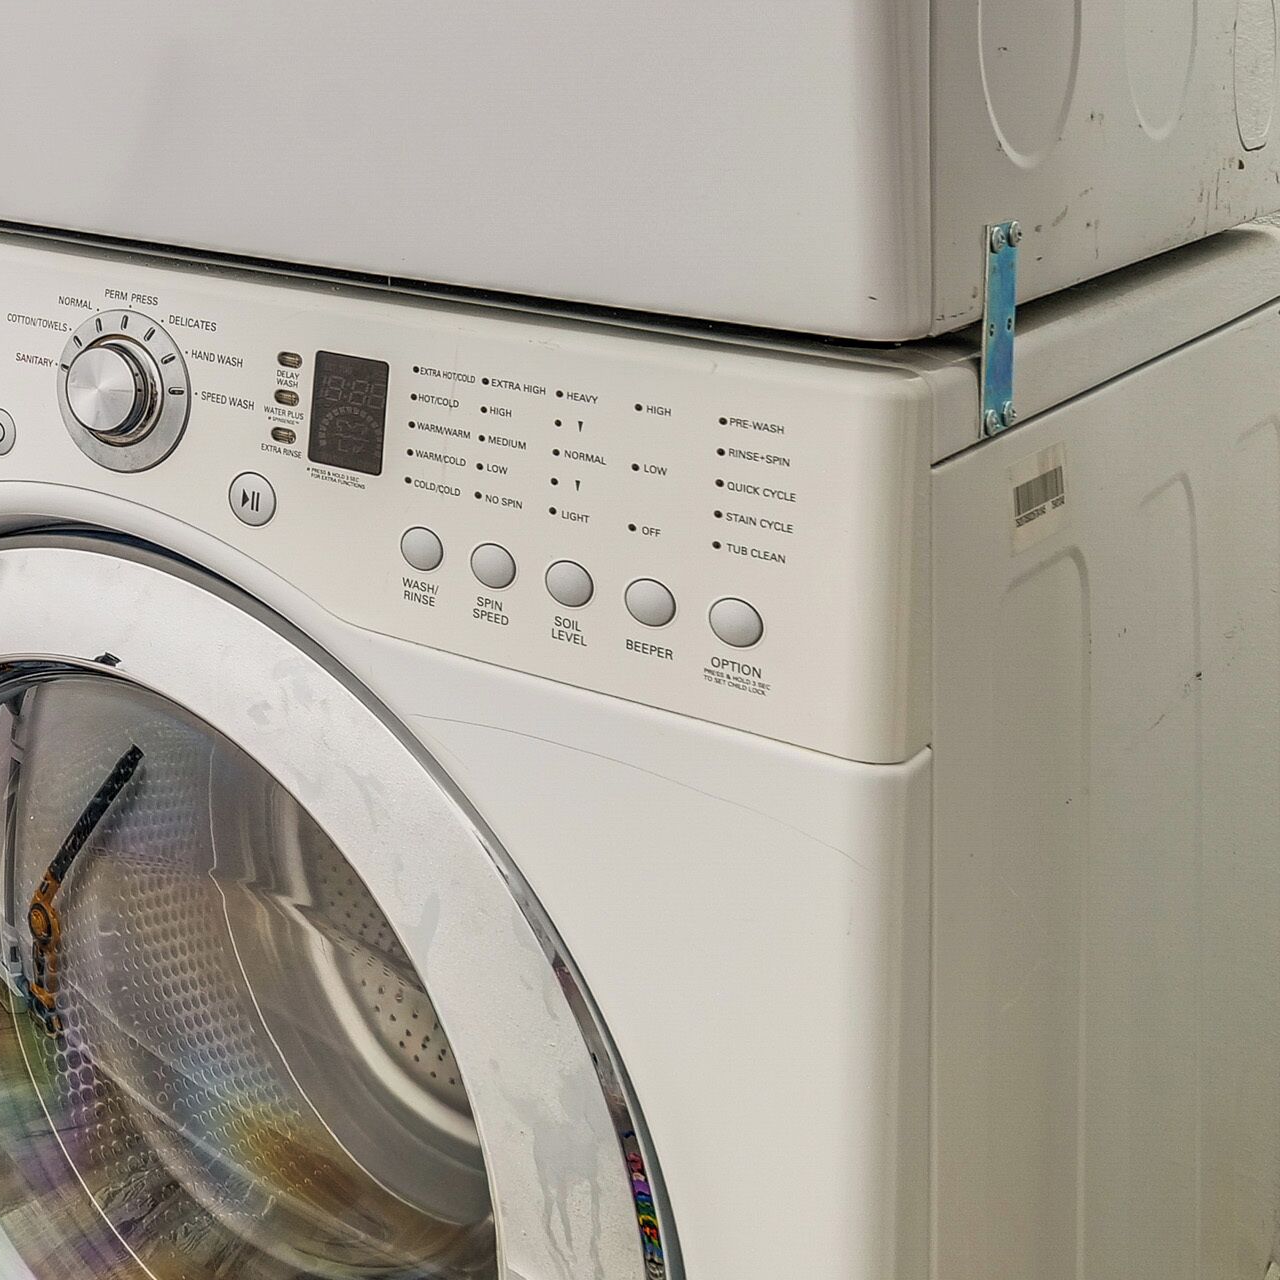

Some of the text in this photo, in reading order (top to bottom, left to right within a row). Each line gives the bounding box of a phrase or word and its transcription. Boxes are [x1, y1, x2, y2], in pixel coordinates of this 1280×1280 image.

[58, 295, 93, 310] NORMAL
[104, 288, 159, 306] PERM PRESS
[6, 312, 68, 332] COTTON/TOWELS
[168, 314, 217, 332] DELICATES
[15, 352, 54, 368] SANITARY
[191, 349, 244, 368] HAND WASH
[276, 370, 300, 381] DELAY
[276, 378, 299, 388] WASH
[420, 366, 476, 384] EXTRA HOT/COLD
[491, 378, 546, 395] EXTRA HIGH
[201, 391, 255, 411] SPEED WASH
[418, 393, 460, 408] HOT/COLD
[566, 391, 598, 404] HEAVY
[263, 404, 305, 420] WATER PLUS
[489, 406, 512, 418] HIGH
[646, 405, 672, 417] HIGH
[416, 421, 471, 440] WARM/WARM
[729, 417, 785, 435] PRE-WASH
[260, 443, 302, 459] EXTRA RINSE
[487, 435, 527, 450] MEDIUM
[415, 449, 466, 467] WARM/COLD
[564, 450, 607, 466] NORMAL
[728, 448, 791, 468] RINSE+SPIN
[486, 463, 508, 475] LOW
[643, 464, 668, 476] LOW
[414, 479, 461, 497] COLD/COLD
[727, 481, 797, 503] QUICK CYCLE
[485, 494, 523, 509] NO SPIN
[561, 510, 590, 523] LIGHT
[726, 512, 794, 534] STAIN CYCLE
[641, 526, 662, 537] OFF
[726, 542, 786, 564] TUB CLEAN
[402, 576, 440, 596] WASH/
[403, 590, 436, 607] RINSE
[476, 596, 503, 612] SPIN
[472, 608, 509, 626] SPEED
[554, 616, 582, 632] SOIL
[551, 628, 588, 647] LEVEL
[625, 638, 674, 660] BEEPER
[710, 656, 762, 679] OPTION
[704, 668, 725, 678] PRESS
[732, 676, 751, 685] HOLD
[704, 674, 713, 682] TO
[727, 681, 748, 691] CHILD
[748, 687, 767, 696] LOCK
